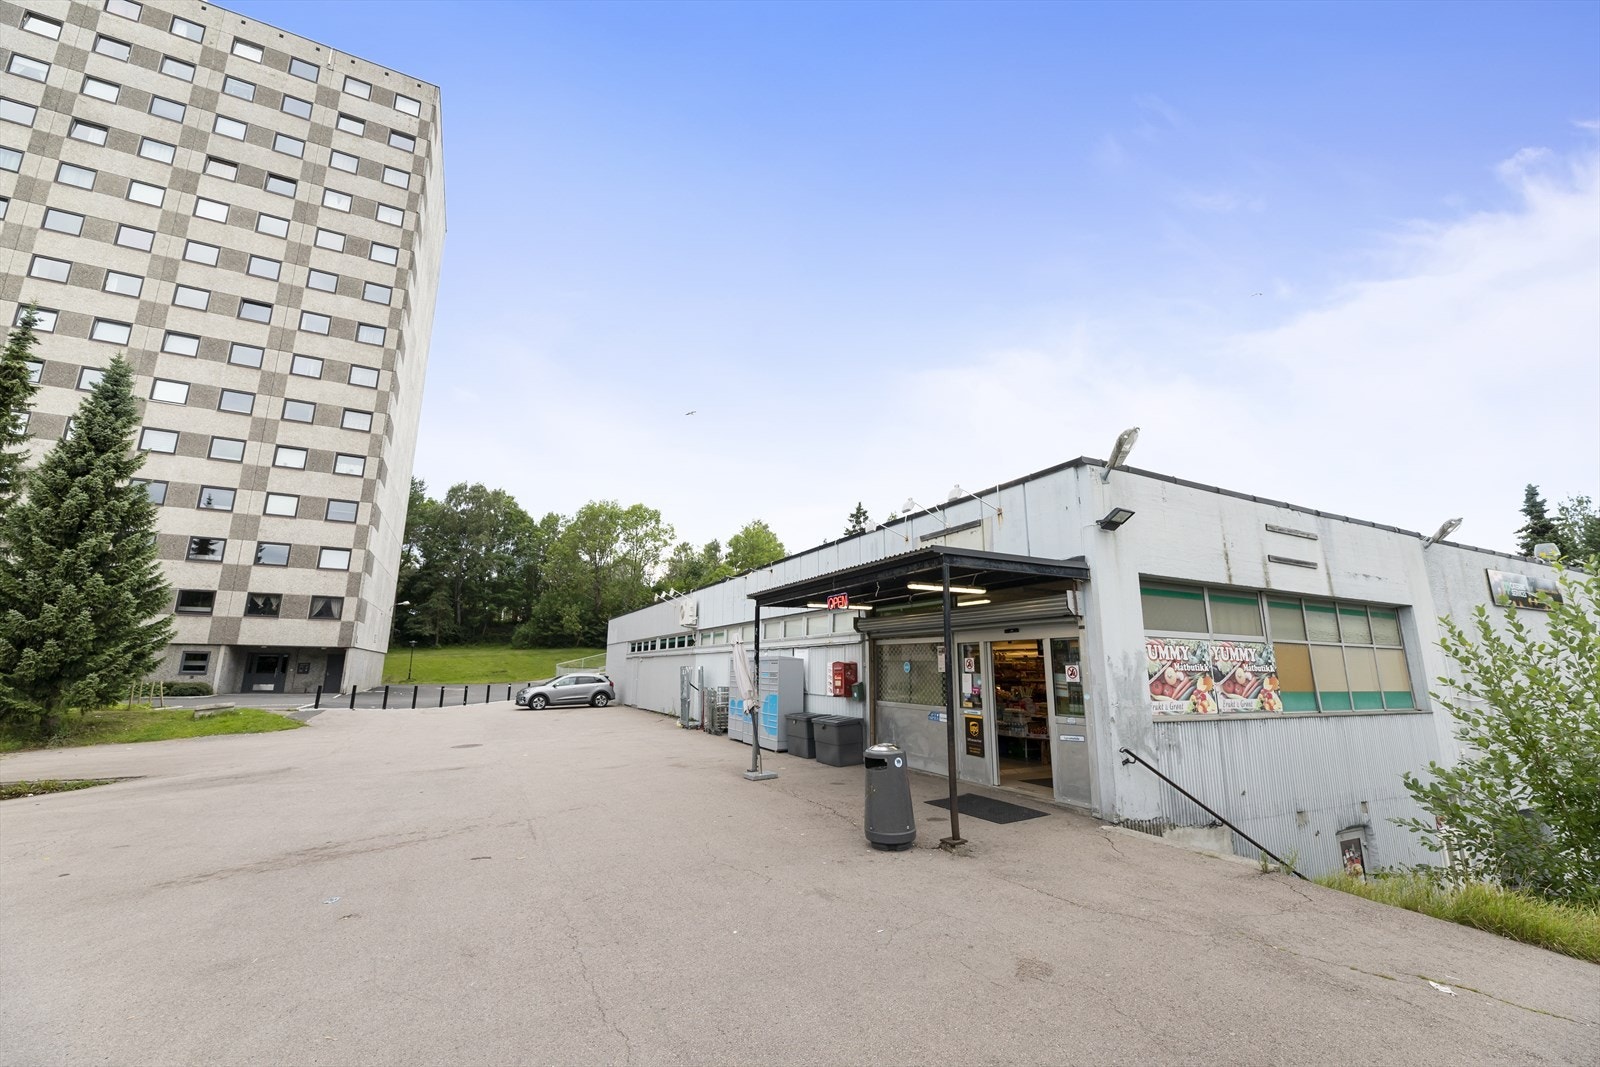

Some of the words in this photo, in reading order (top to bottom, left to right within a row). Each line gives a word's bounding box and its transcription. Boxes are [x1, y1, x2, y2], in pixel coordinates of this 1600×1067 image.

[828, 595, 847, 610] OPEN
[1146, 644, 1190, 661] UMMY
[1211, 645, 1257, 662] YUMMY
[1174, 662, 1210, 672] Matbutikk
[1243, 663, 1276, 673] Matbutikk
[1152, 702, 1164, 711] rukt
